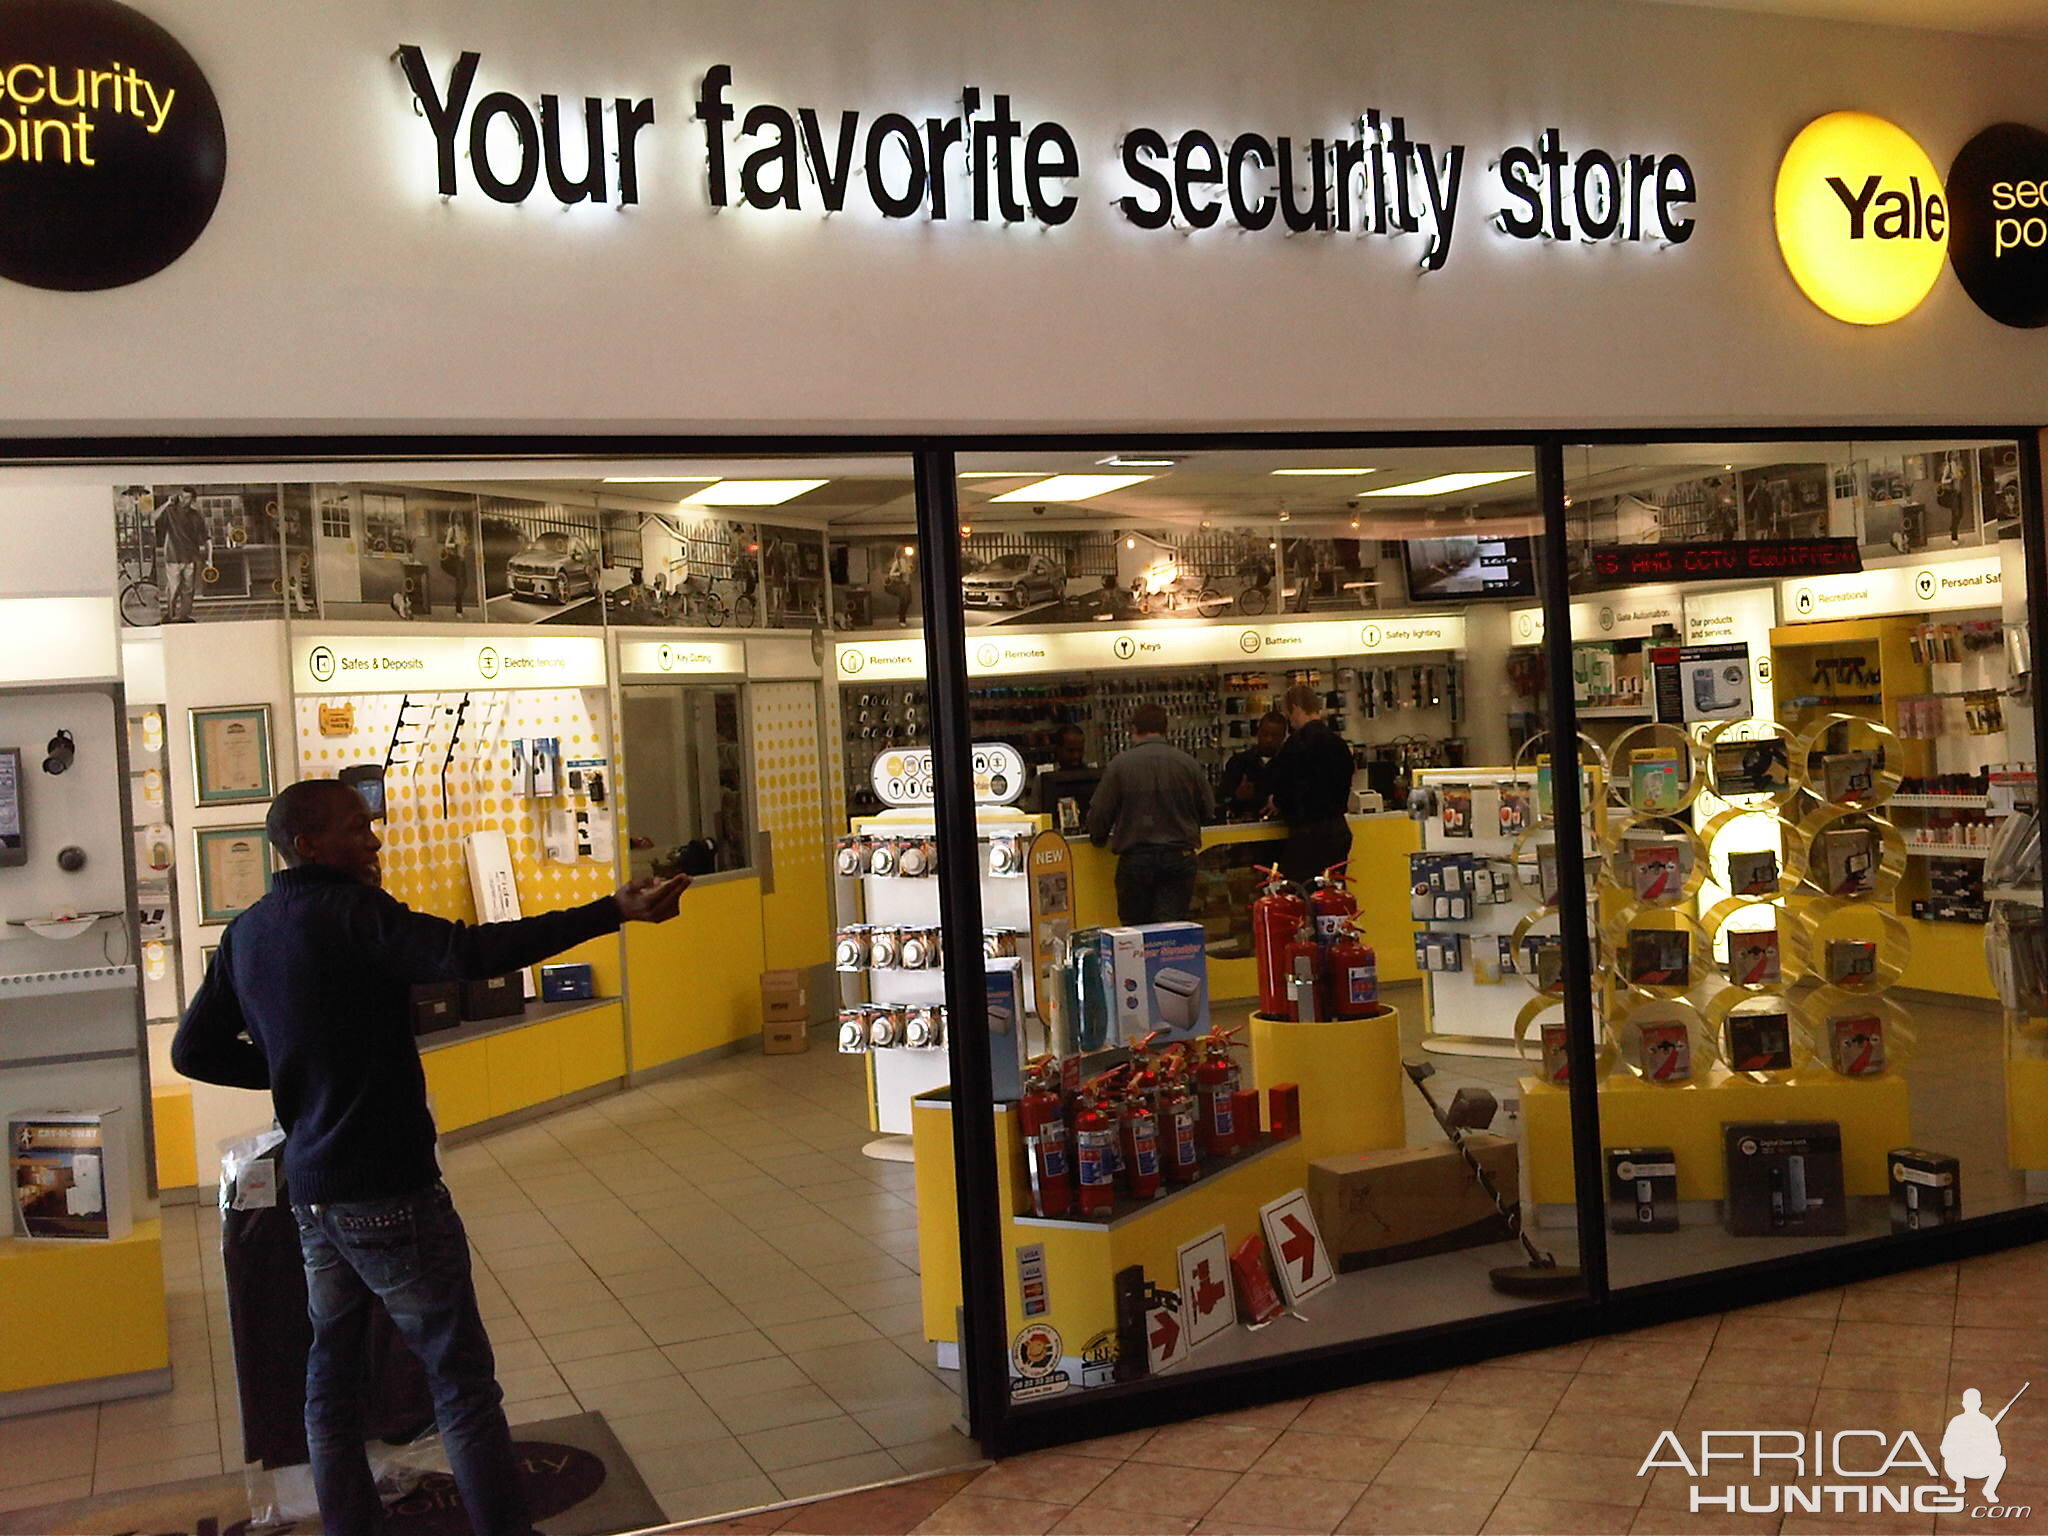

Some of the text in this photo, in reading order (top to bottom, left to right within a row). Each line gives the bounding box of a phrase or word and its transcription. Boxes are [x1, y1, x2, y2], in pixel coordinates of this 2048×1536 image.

[0, 62, 176, 134] curity
[399, 44, 1697, 270] Your favorite security store
[1825, 175, 1947, 240] Yale
[1684, 549, 1737, 571] CCTV
[1941, 576, 1983, 588] Personal
[1690, 616, 1733, 627] Our products
[1265, 635, 1303, 646] Batteries
[1385, 628, 1441, 642] Safety lighting
[1691, 630, 1703, 639] and
[1140, 642, 1162, 652] Keys
[1004, 649, 1046, 659] Remotes
[341, 657, 424, 671] Safes & Deposits
[504, 657, 534, 668] Electric
[869, 656, 913, 666] Remotes
[1036, 849, 1064, 865] NEW
